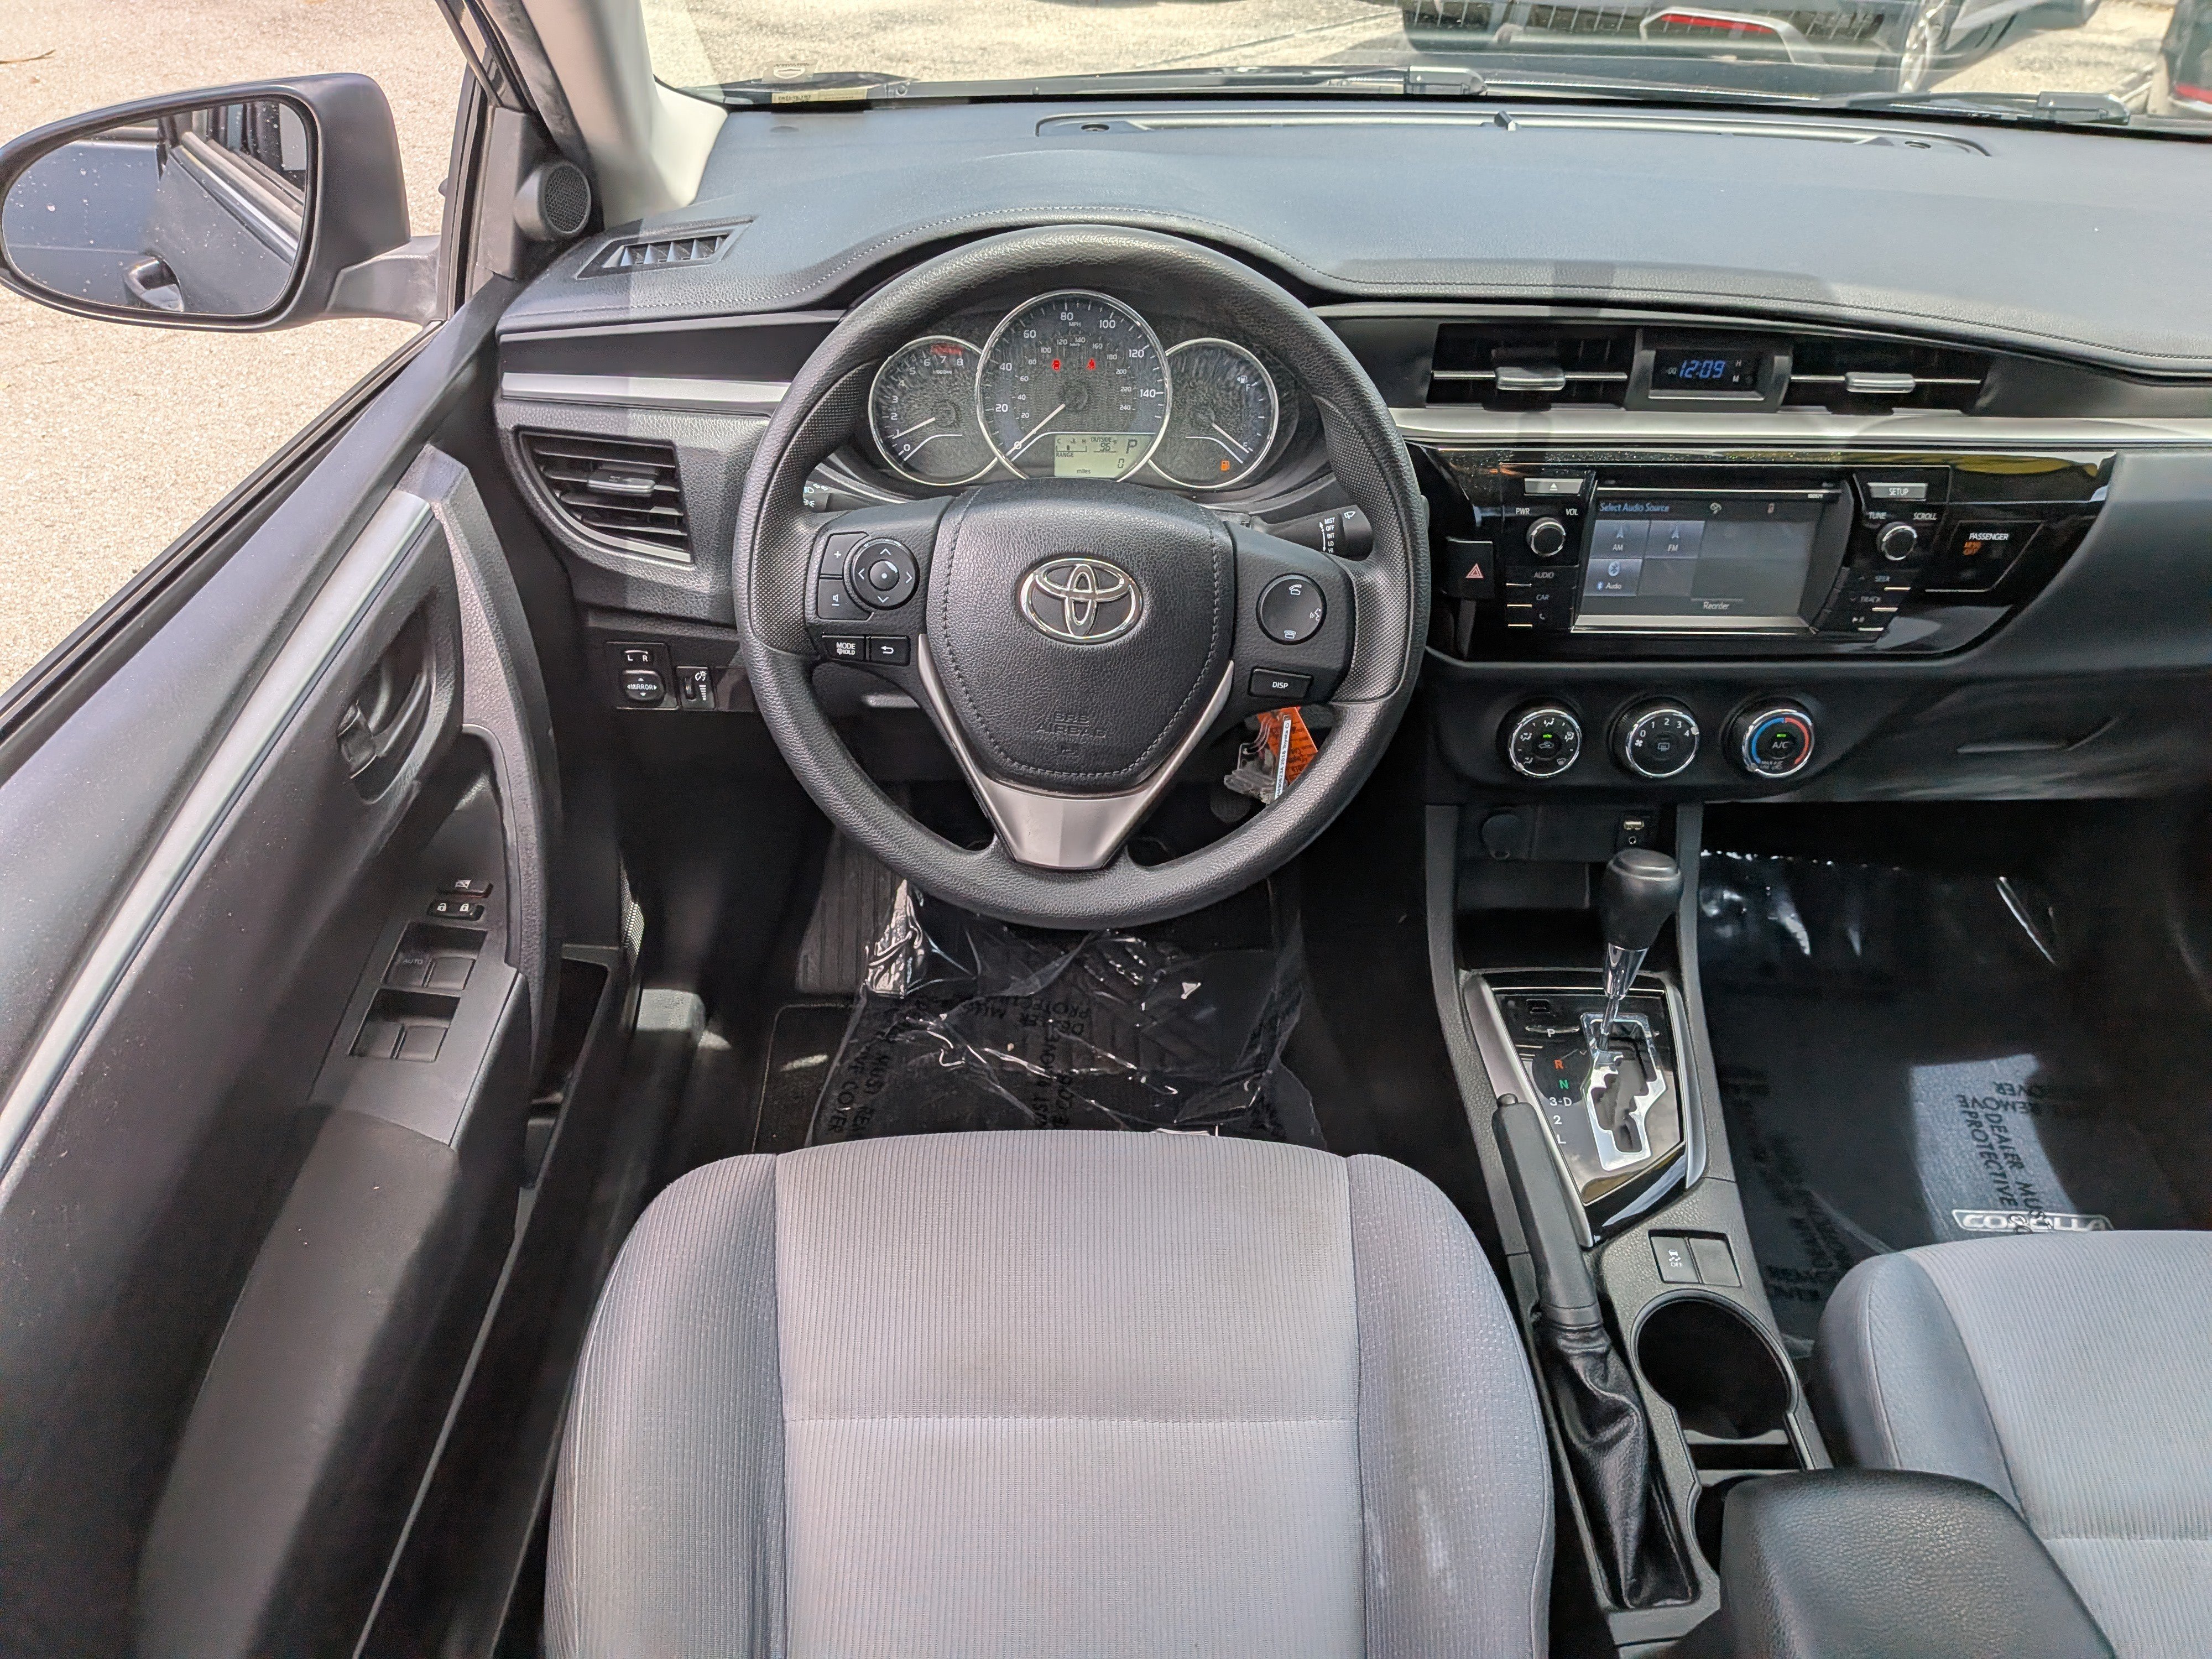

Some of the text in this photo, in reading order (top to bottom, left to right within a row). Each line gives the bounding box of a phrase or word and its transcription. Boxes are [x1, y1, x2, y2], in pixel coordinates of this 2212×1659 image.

[1060, 312, 1073, 321] 80
[1099, 320, 1116, 328] 100
[1024, 330, 1036, 338] 60
[1129, 349, 1145, 358] 120
[957, 358, 963, 366] 8
[999, 363, 1013, 372] 40
[1679, 360, 1726, 379] 12:09
[1140, 389, 1156, 398] 140
[995, 404, 1008, 412] 20
[1014, 441, 1022, 450] 0
[1125, 439, 1138, 454] P
[1117, 458, 1125, 469] 0
[1599, 502, 1670, 512] Select Audio Source
[1913, 512, 1937, 520] SCROLL
[1703, 601, 1730, 610] Reorder
[1547, 1028, 1555, 1037] P
[1554, 1060, 1564, 1069] R
[1559, 1079, 1569, 1089] N
[1549, 1097, 1572, 1106] 3-D
[1553, 1115, 1562, 1125] 2
[1557, 1135, 1567, 1144] L
[1985, 1109, 2025, 1170] DEALER
[1962, 1109, 2018, 1207] PROTECTIVE
